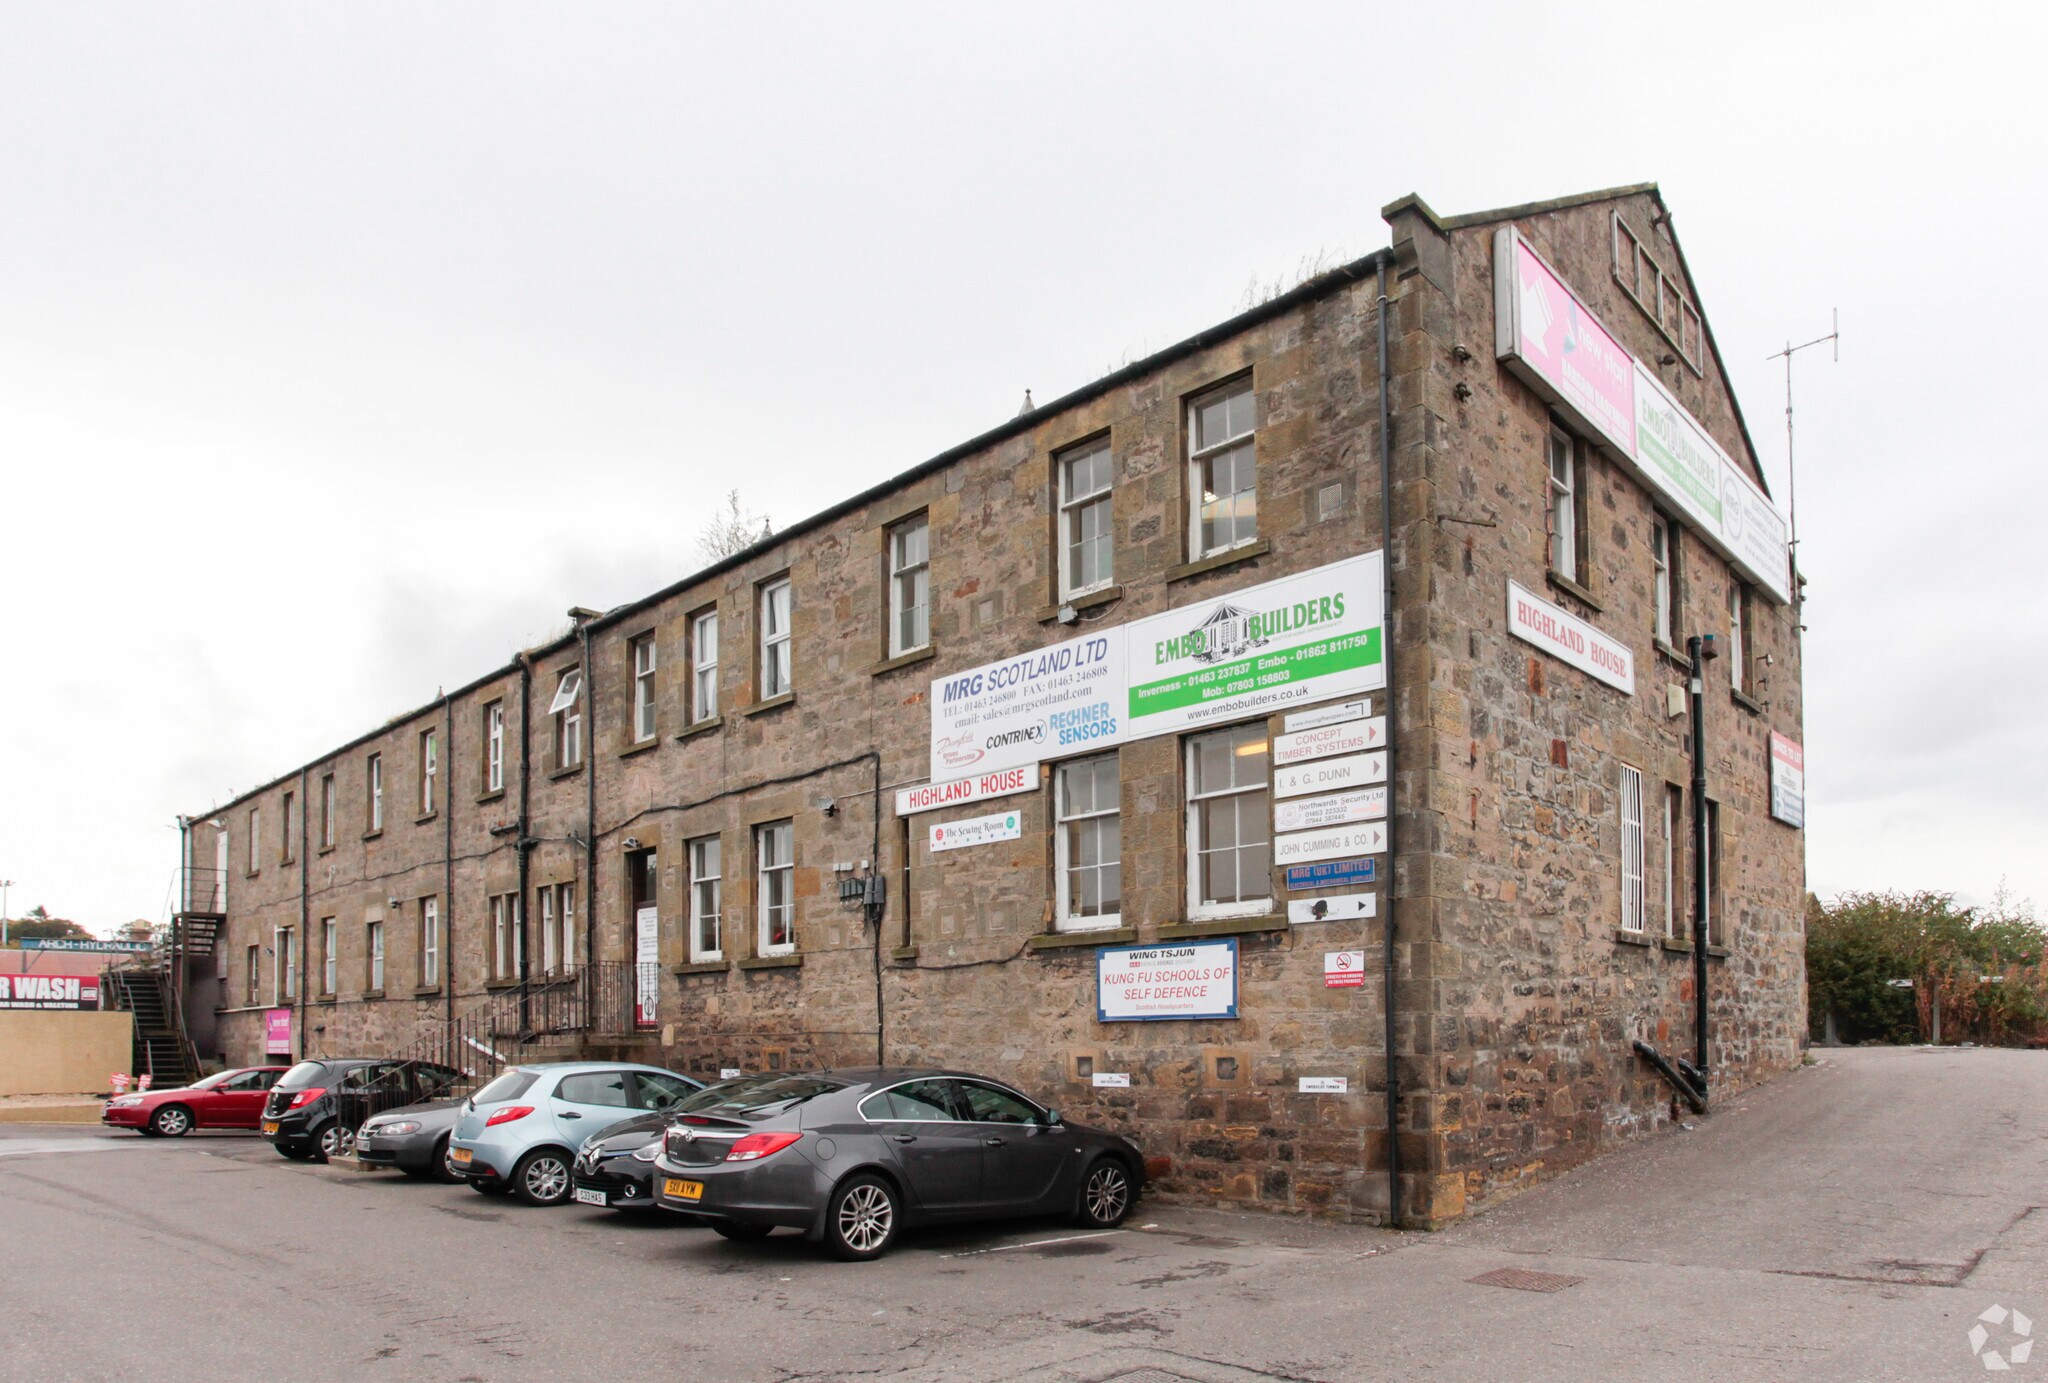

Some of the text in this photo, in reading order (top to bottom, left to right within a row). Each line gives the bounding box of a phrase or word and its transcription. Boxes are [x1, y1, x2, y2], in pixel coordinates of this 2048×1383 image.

[1642, 396, 1666, 443] EMBO
[1681, 438, 1715, 490] BUILDERS
[1156, 592, 1345, 665] EMBO BUILDERS
[1517, 600, 1626, 678] HIGHLAND HOUSE
[943, 638, 1108, 704] MRG SCOTLAND LTD
[1138, 682, 1180, 699] Inverness
[1188, 671, 1216, 688] 01463
[1218, 662, 1250, 681] 237837
[1258, 655, 1288, 670] Embo
[1296, 646, 1328, 661] 01862
[1330, 634, 1368, 653] 811750
[942, 665, 1108, 718] TEL: 01463 246800 FAX: 01463 246808
[1202, 670, 1290, 699] Mob: 07803 158803
[954, 686, 1092, 729] email: sales@mrgscotland.com
[1187, 685, 1308, 720] www.embobuilders.co.uk
[986, 725, 1044, 750] CONTRINEX
[1059, 718, 1117, 745] SENSORS
[1296, 728, 1342, 746] CONCEPT
[1277, 736, 1364, 760] TIMBER SYSTEMS
[910, 769, 1024, 808] HIGHLAND HOUSE
[1290, 776, 1296, 787] &
[1302, 774, 1314, 784] G.
[1318, 767, 1351, 782] DUNN
[1298, 792, 1384, 812] Northwards Security Ltd
[945, 821, 1004, 838] The Sewing Room
[1280, 834, 1368, 856] JOHN CUMMING & CO.
[1292, 860, 1370, 878] MRG (UK) LIMITED
[1129, 948, 1196, 960] WING TSJUN
[1104, 967, 1230, 984] KUNG FU SCHOOLS OF
[14, 977, 80, 1000] WASH
[1124, 986, 1208, 1000] SELF DEFENCE
[1158, 1002, 1194, 1010] Headquarters
[581, 1190, 602, 1202] S33 HAS
[680, 1182, 696, 1195] AYM
